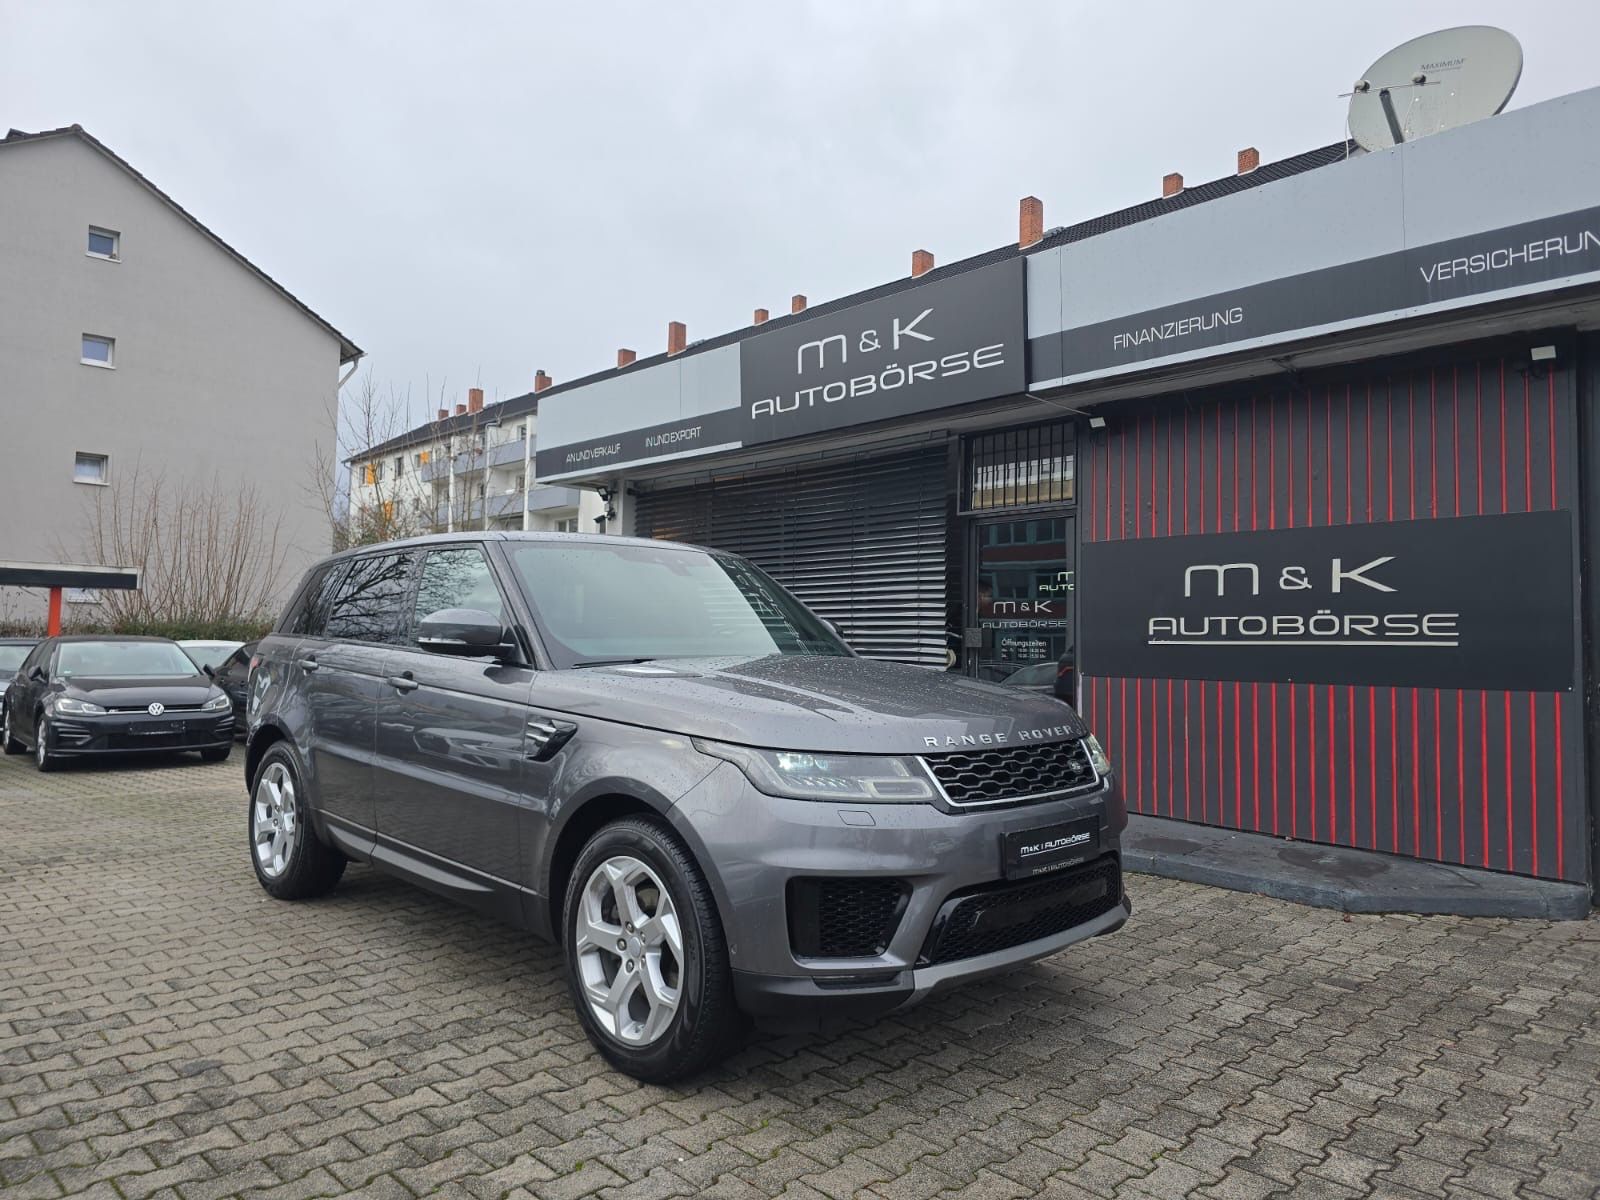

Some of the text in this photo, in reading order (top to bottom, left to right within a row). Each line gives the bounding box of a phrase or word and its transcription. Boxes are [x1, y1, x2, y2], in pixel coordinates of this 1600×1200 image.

[797, 307, 936, 375] M & K
[1113, 306, 1243, 351] FINANZIERUNG
[751, 343, 1005, 420] AUTOBÖRSE
[671, 426, 702, 442] EXPORT
[1184, 556, 1399, 598] M & K
[993, 600, 1053, 614] M & K
[982, 619, 1068, 629] AUTOBÖRSE
[1148, 609, 1460, 636] AUTOBÖRSE
[923, 724, 1074, 748] RANGE ROVER
[1044, 832, 1090, 849] AUTOBÖRSE
